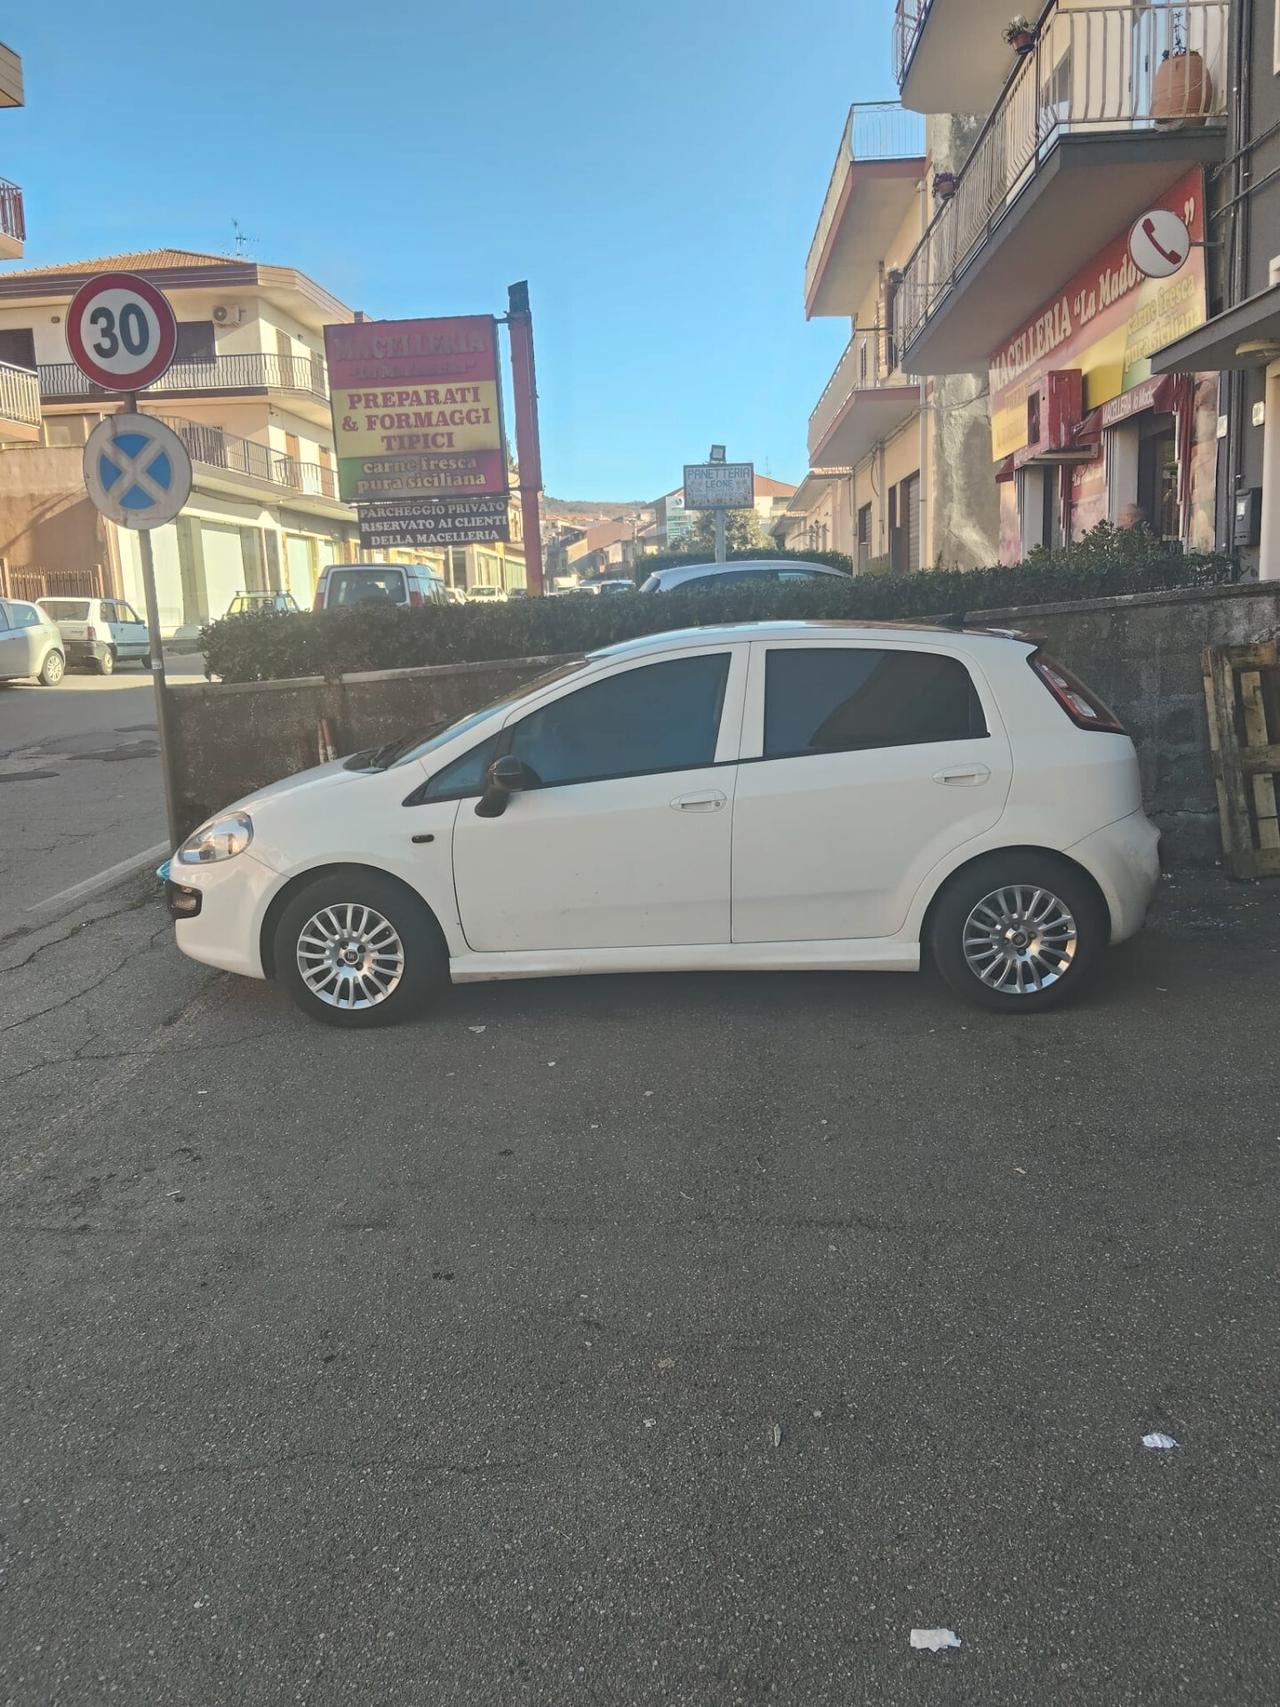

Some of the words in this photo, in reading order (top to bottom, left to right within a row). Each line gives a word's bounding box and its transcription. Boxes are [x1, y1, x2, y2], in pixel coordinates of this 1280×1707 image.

[90, 303, 149, 359] 30
[991, 296, 1072, 391] MACELLERIA
[348, 387, 480, 410] PREPARATI
[342, 416, 359, 432] &
[365, 408, 491, 431] FORMAGGI
[381, 432, 455, 451] TIPICI
[363, 457, 420, 474] carne
[421, 456, 477, 471] fresca
[687, 467, 750, 479] PANETTERIA
[357, 477, 407, 494] pura
[407, 472, 486, 488] siciliana
[705, 480, 733, 489] LEONE
[360, 503, 445, 519] PARCHEGGIO
[448, 501, 505, 515] PRIVATO
[361, 519, 435, 533] RISERVATO
[438, 517, 452, 529] AI
[454, 515, 508, 528] CLIENTI
[371, 533, 413, 546] DELLA
[416, 530, 499, 544] MACELLERIA
